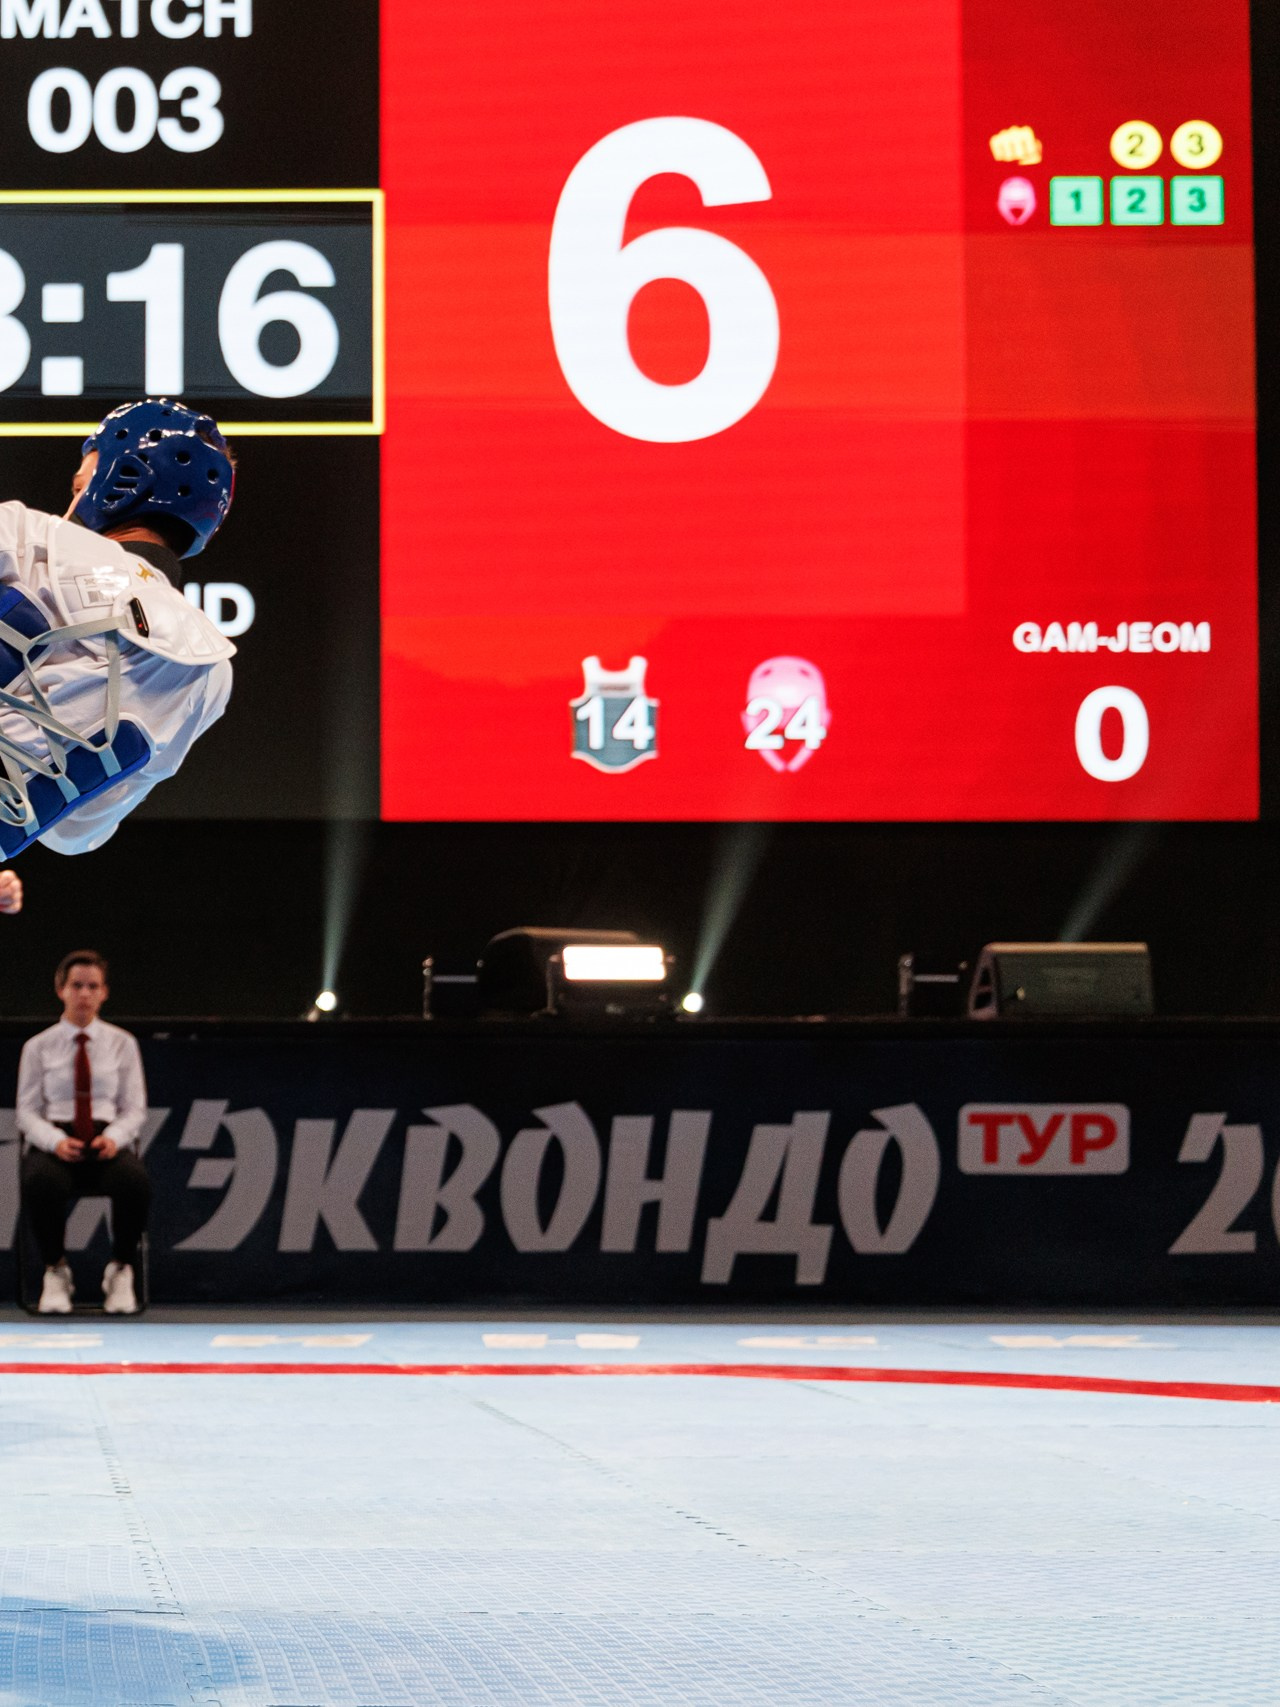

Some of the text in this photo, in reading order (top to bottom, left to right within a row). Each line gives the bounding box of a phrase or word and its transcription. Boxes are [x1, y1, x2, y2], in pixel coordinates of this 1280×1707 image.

[0, 0, 253, 39] MATCH
[27, 67, 225, 154] 003
[1127, 132, 1204, 157] 2 3
[1127, 187, 1147, 214] 2
[1188, 187, 1207, 213] 3
[548, 116, 781, 444] 6
[1012, 621, 1212, 654] GAM-JEOM
[576, 695, 655, 750] 14
[743, 696, 827, 750] 24
[1074, 686, 1151, 782] 0
[969, 1112, 1119, 1167] ТУР
